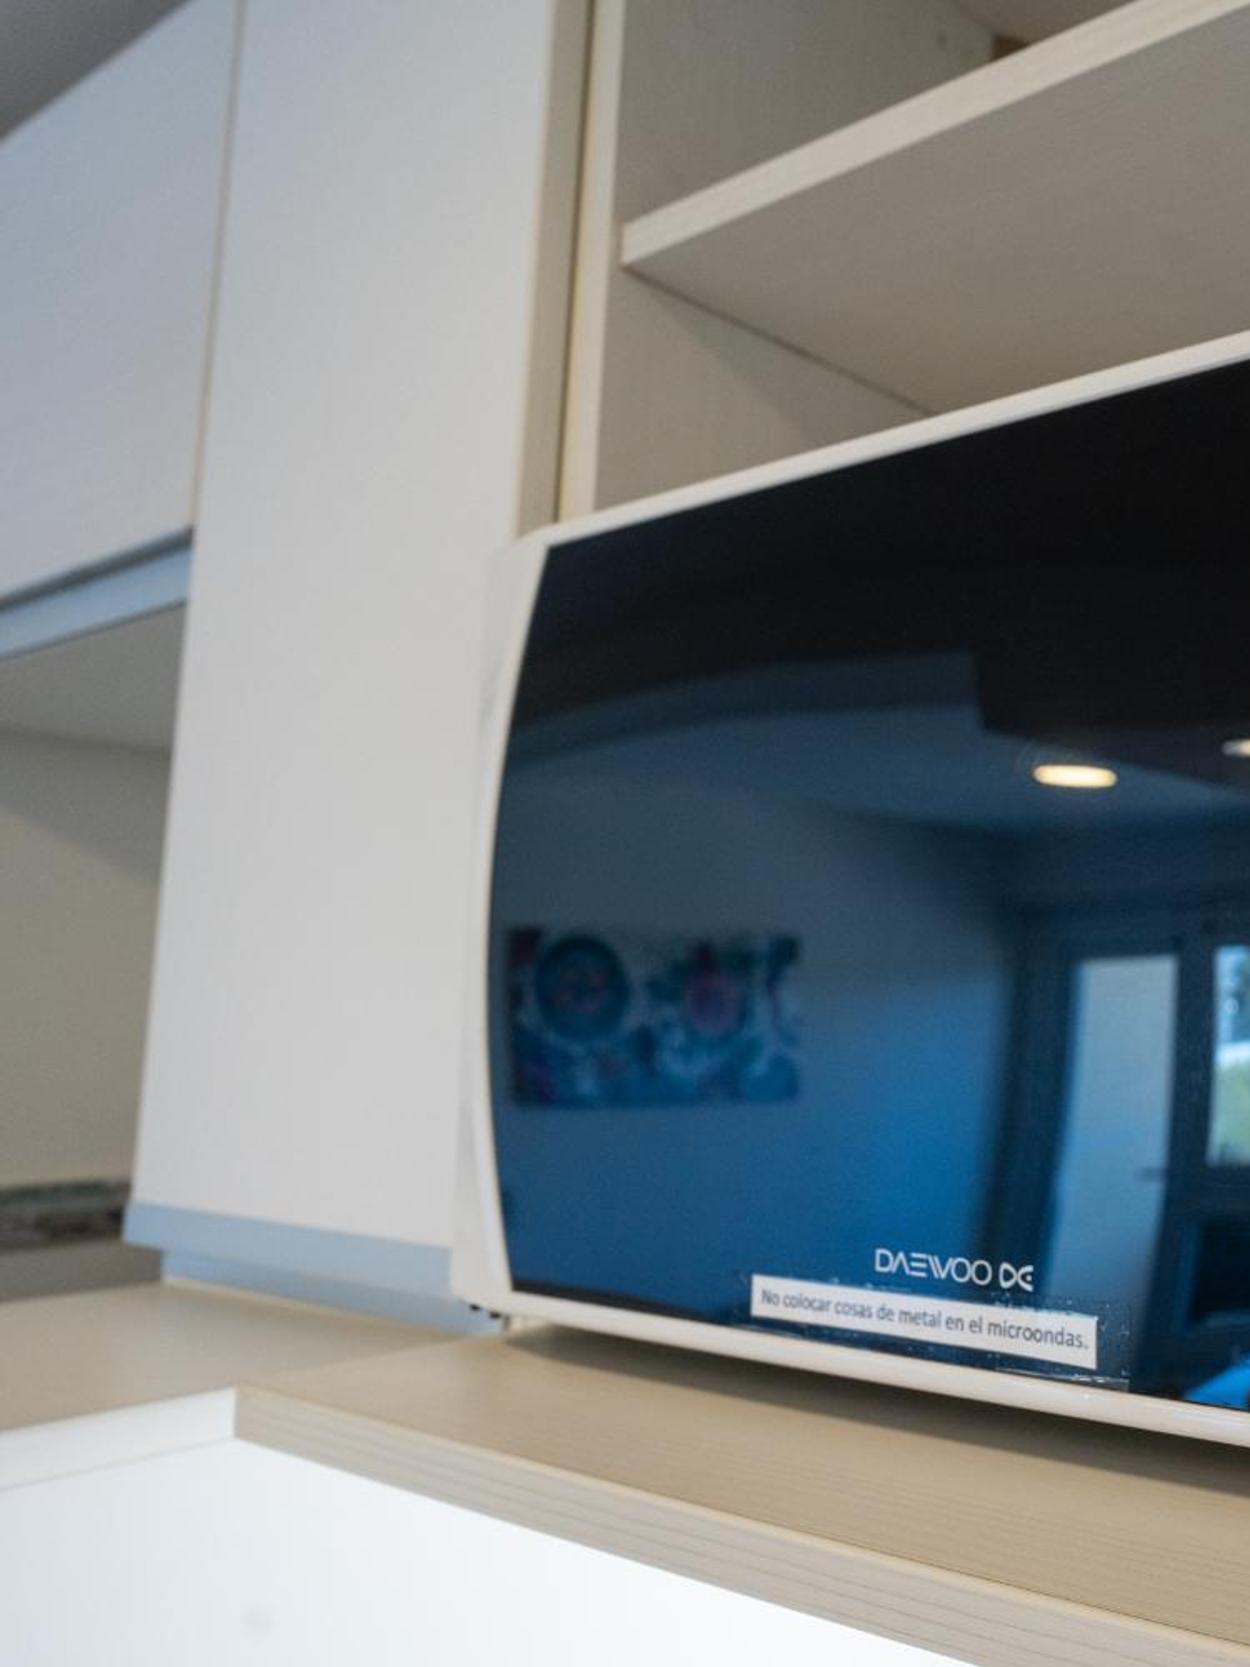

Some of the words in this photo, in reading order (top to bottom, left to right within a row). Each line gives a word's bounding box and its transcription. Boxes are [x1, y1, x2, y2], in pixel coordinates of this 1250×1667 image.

[874, 1248, 993, 1286] DAEWOO
[761, 1289, 781, 1307] No
[783, 1292, 831, 1314] colocar
[834, 1300, 873, 1319] cosas
[876, 1304, 895, 1322] de
[899, 1307, 942, 1328] metal
[945, 1317, 964, 1333] en
[969, 1316, 983, 1335] el
[987, 1320, 1089, 1349] microondas.
